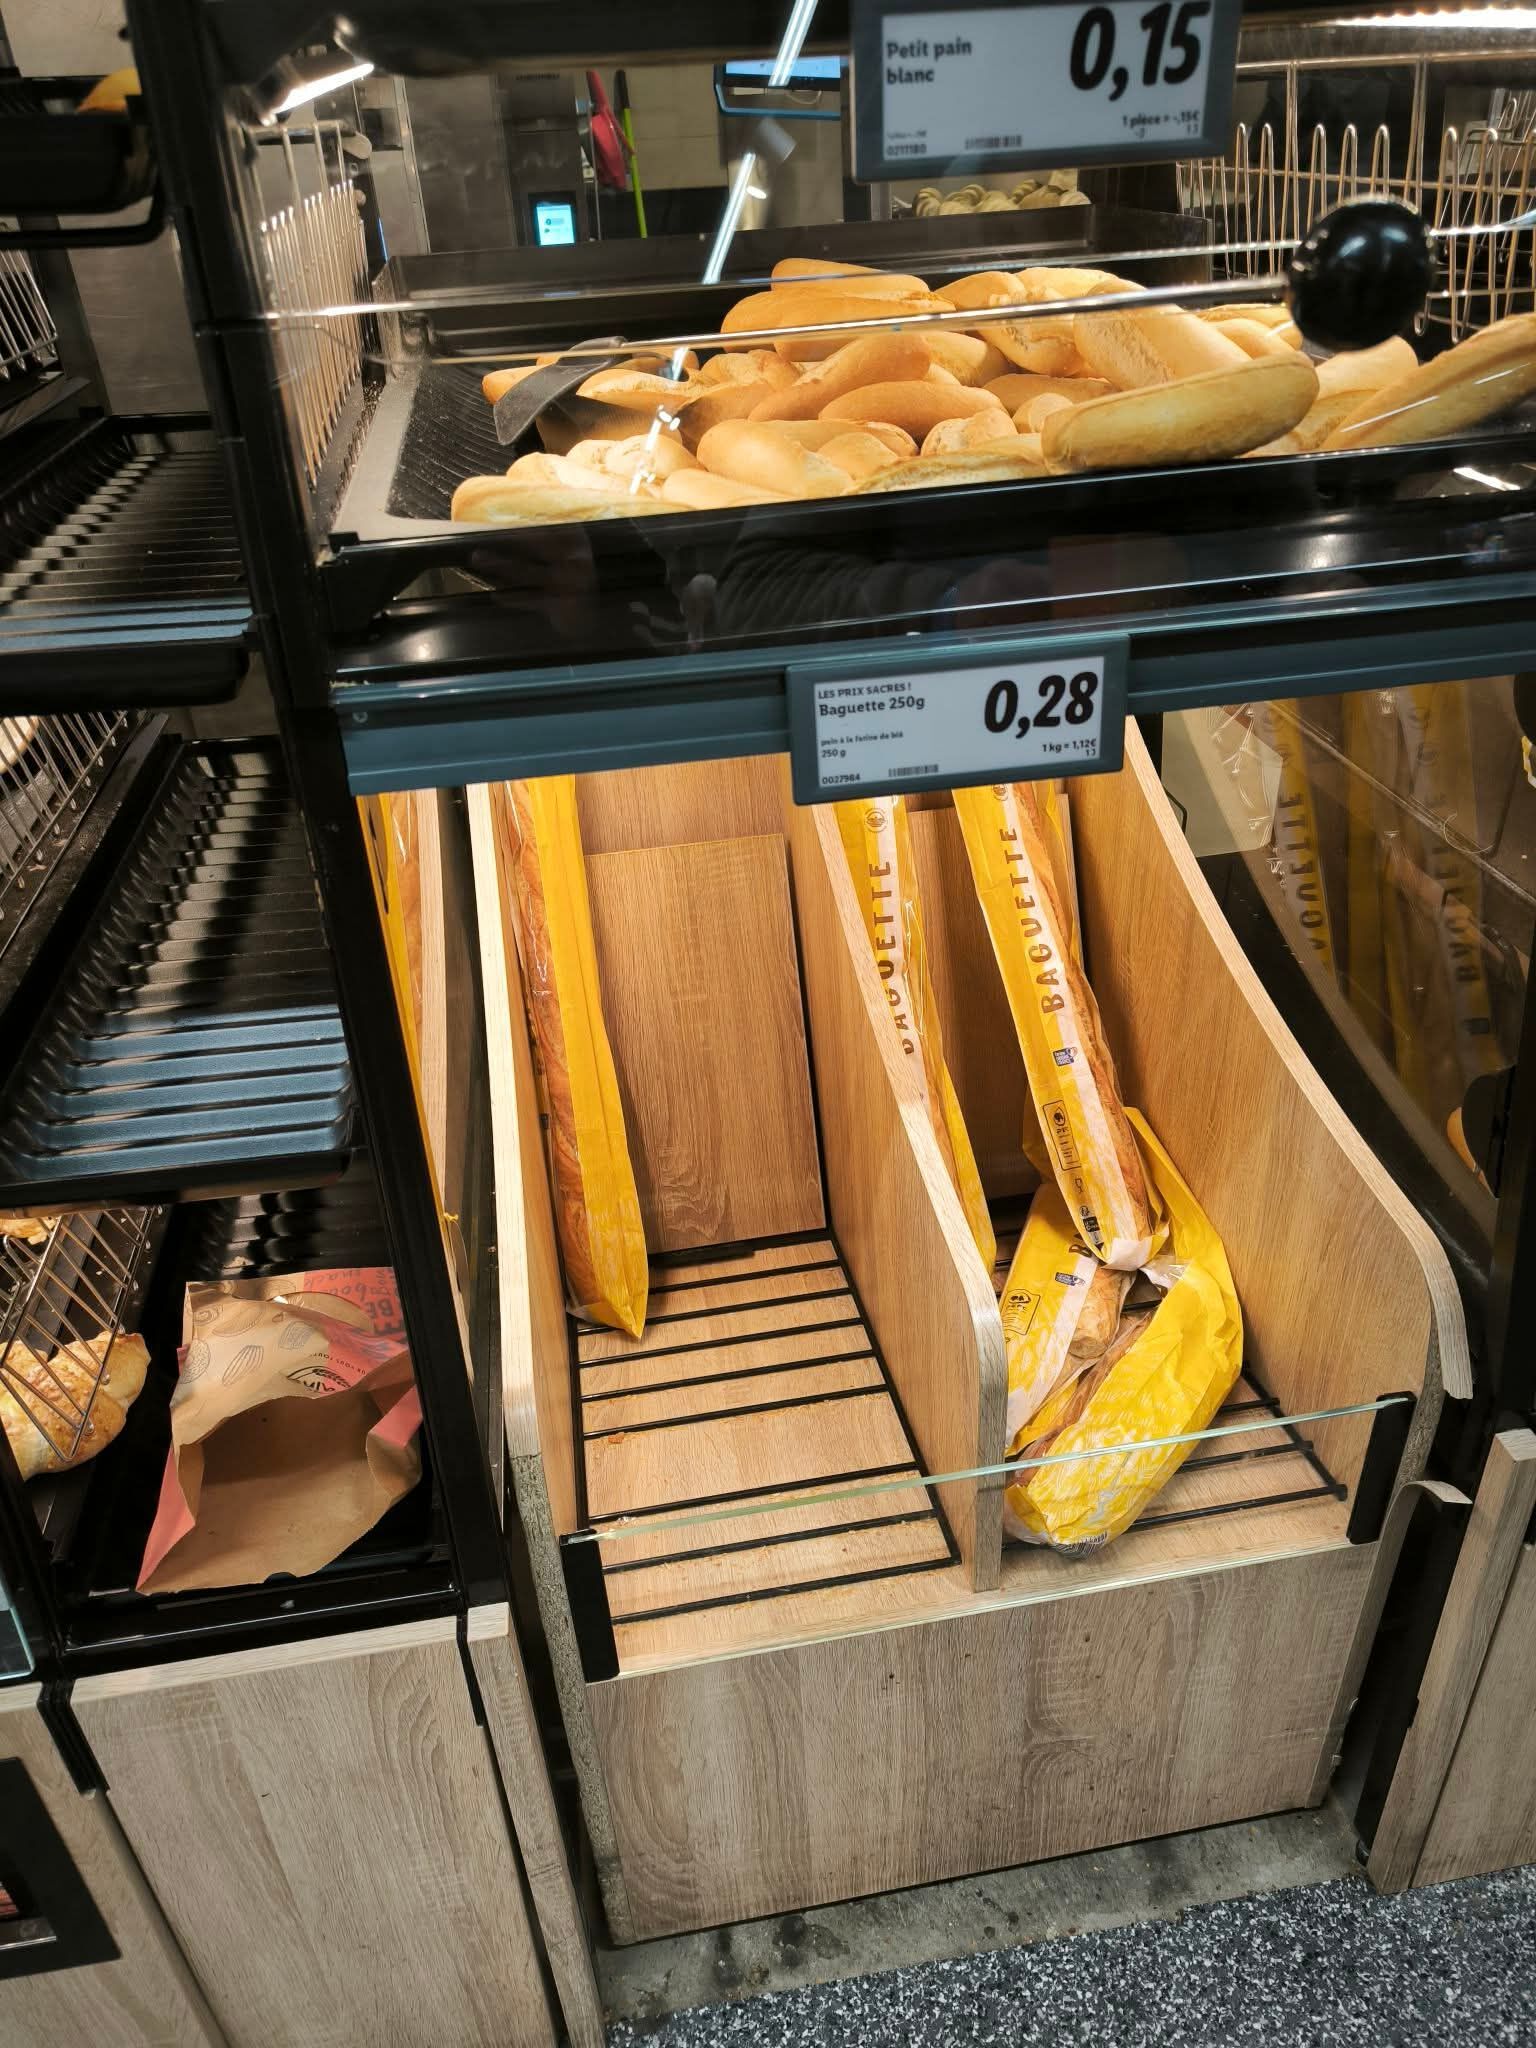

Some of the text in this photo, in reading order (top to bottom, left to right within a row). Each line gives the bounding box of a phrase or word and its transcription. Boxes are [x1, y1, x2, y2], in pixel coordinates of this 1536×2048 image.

[886, 37, 972, 60] Petit pain
[1069, 2, 1212, 101] 0,15
[886, 69, 935, 84] blanc
[818, 689, 835, 700] LES
[838, 687, 863, 698] PRIX
[819, 696, 925, 718] Baguette 250g
[984, 671, 1099, 739] 0,28
[821, 748, 838, 758] 250
[1000, 827, 1065, 1013] BAGUETTE
